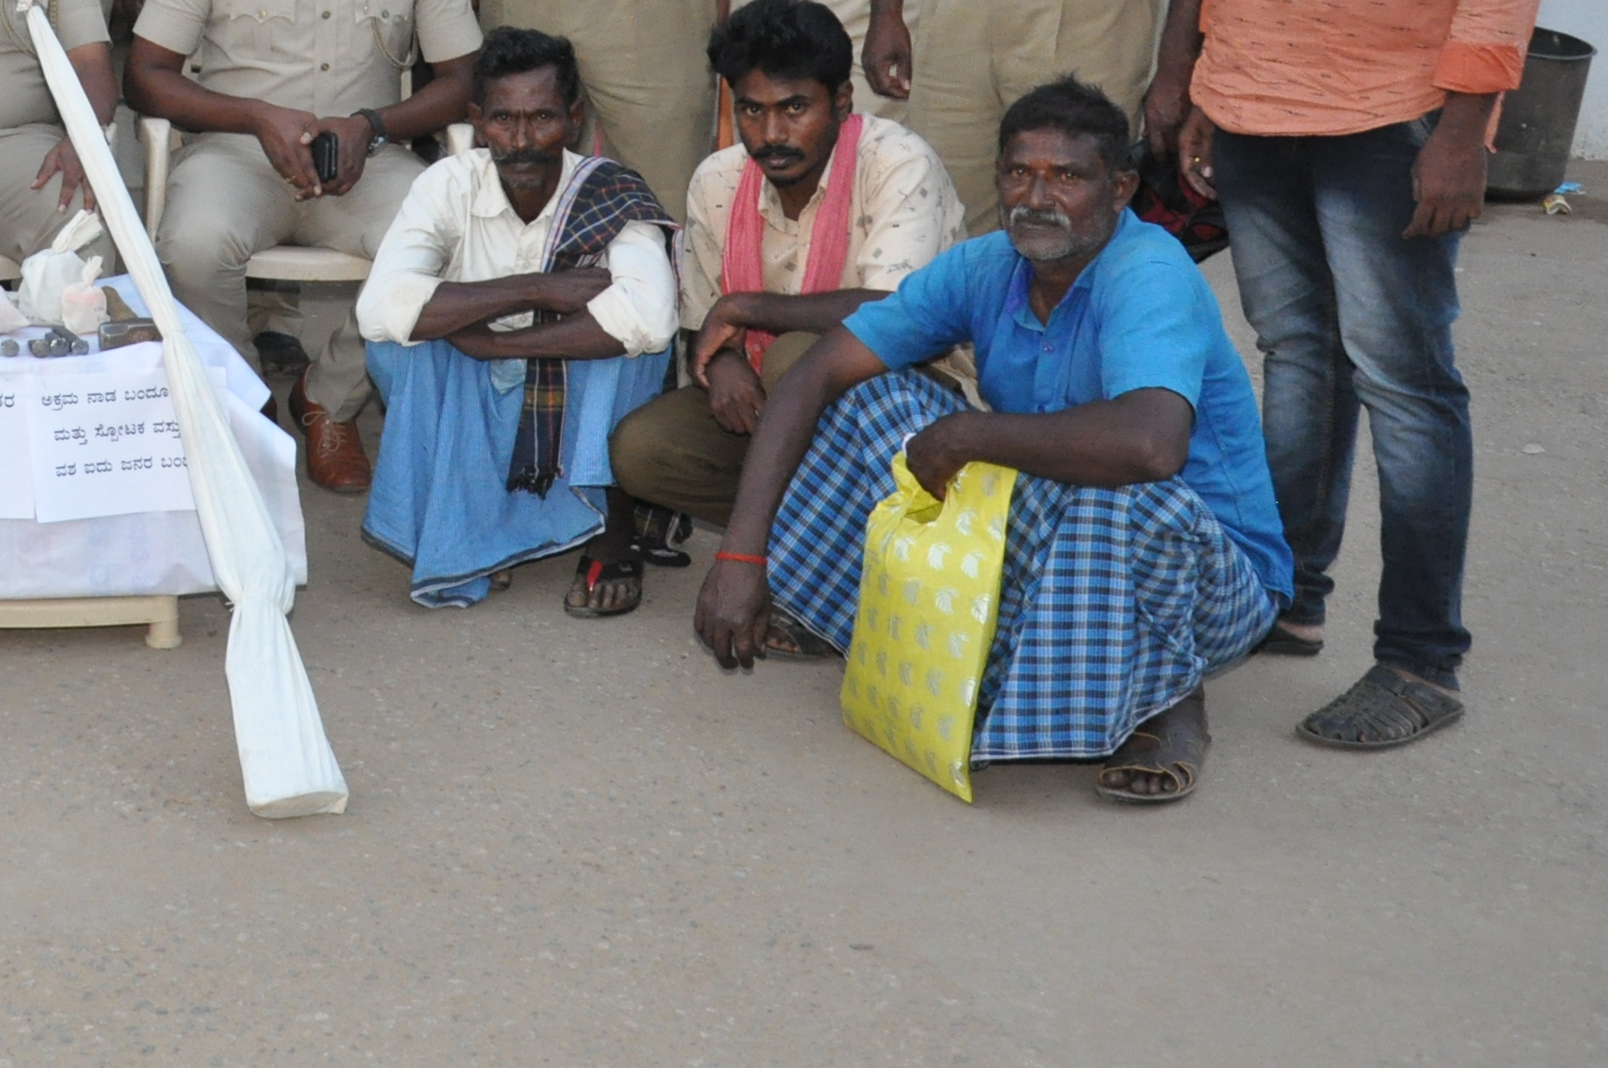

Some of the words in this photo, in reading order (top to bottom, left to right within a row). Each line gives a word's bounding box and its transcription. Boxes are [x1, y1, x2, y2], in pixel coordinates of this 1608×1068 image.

[41, 392, 79, 412] ಅಕ್ರಮ
[86, 389, 117, 404] ನಾಡ
[124, 386, 169, 402] ಬಂದೂ
[54, 426, 89, 446] ಮತ್ತು
[55, 462, 77, 478] ವಶ
[83, 459, 113, 475] ಐದು
[120, 456, 153, 471] ಜನರ
[160, 456, 189, 470] ಬಂ
